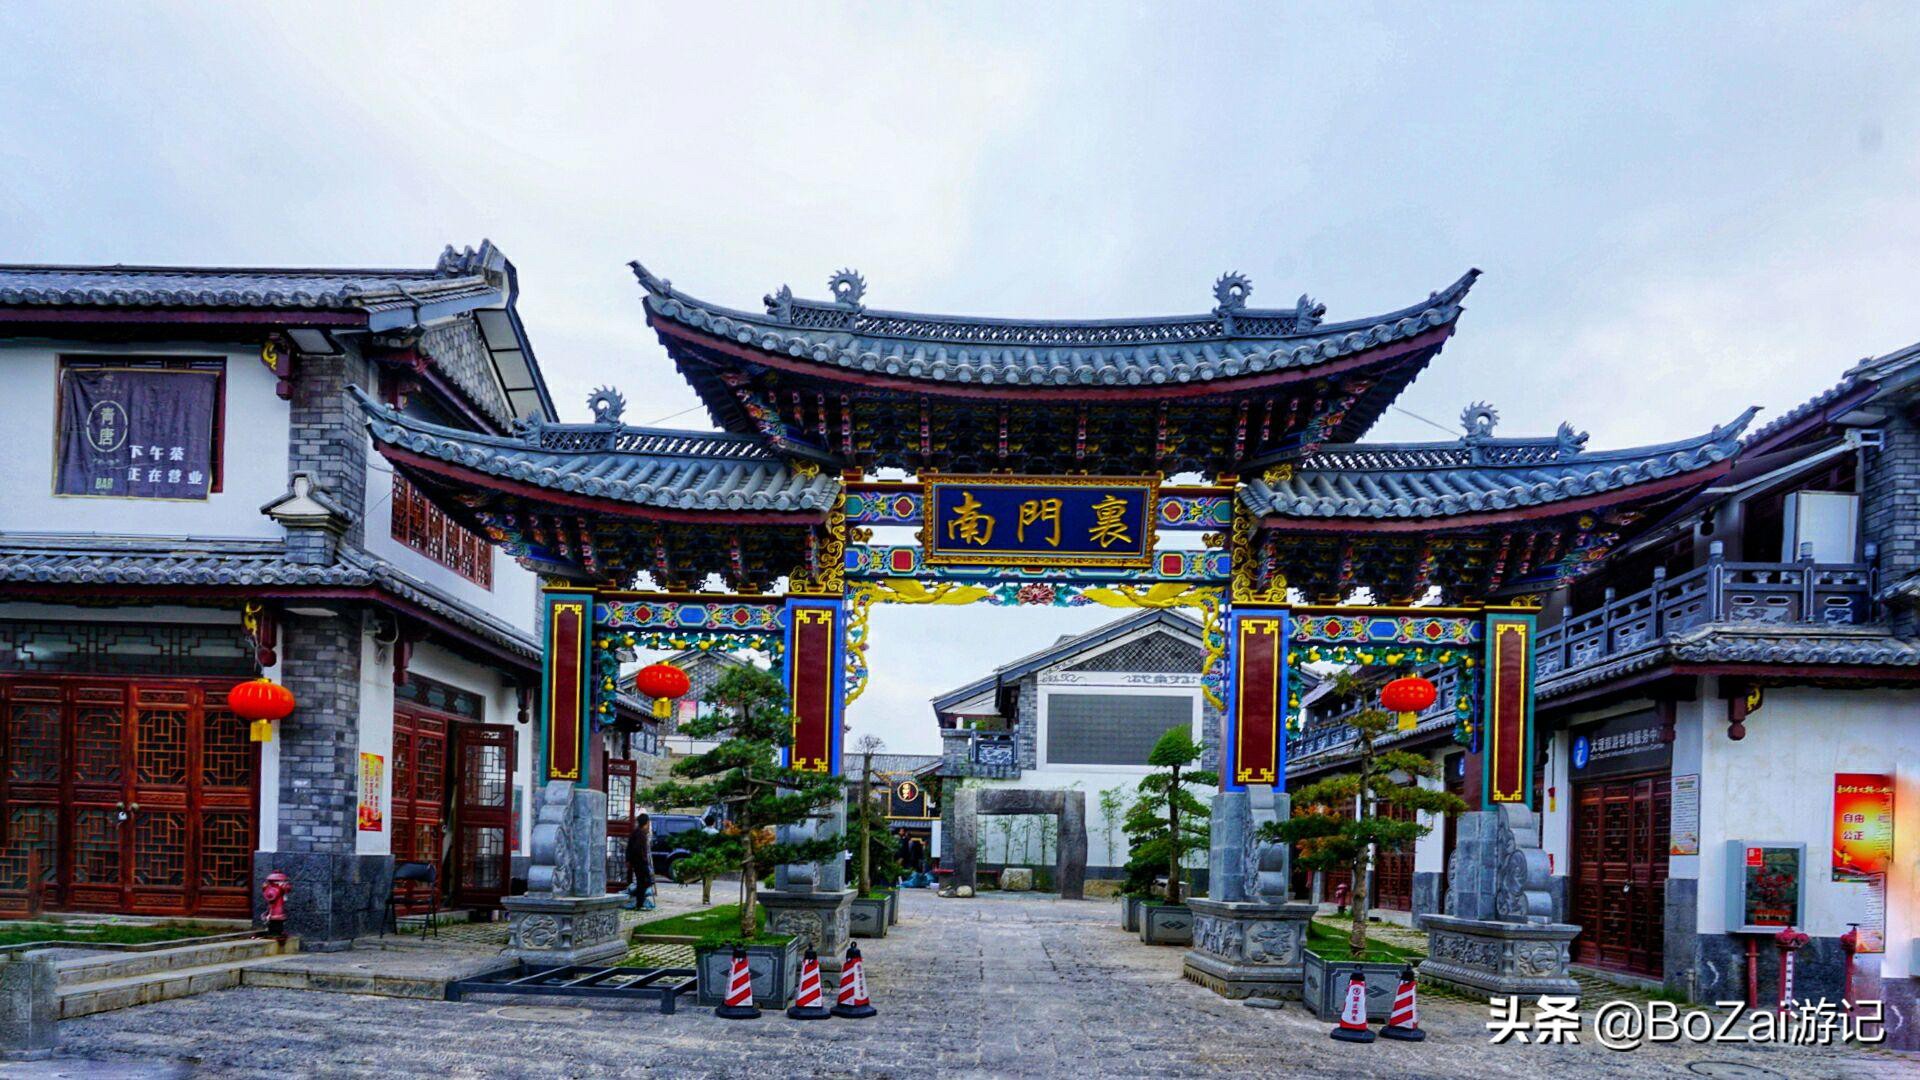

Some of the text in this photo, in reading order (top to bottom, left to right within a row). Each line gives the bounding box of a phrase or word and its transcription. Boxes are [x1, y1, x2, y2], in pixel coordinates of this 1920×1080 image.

[98, 407, 115, 446] 青唐
[128, 445, 185, 461] 下午茶
[95, 477, 114, 490] BAR
[127, 467, 203, 486] 正在营业
[948, 491, 1132, 548] 南門裏
[1843, 813, 1865, 824] 自由
[1843, 830, 1865, 841] 公正
